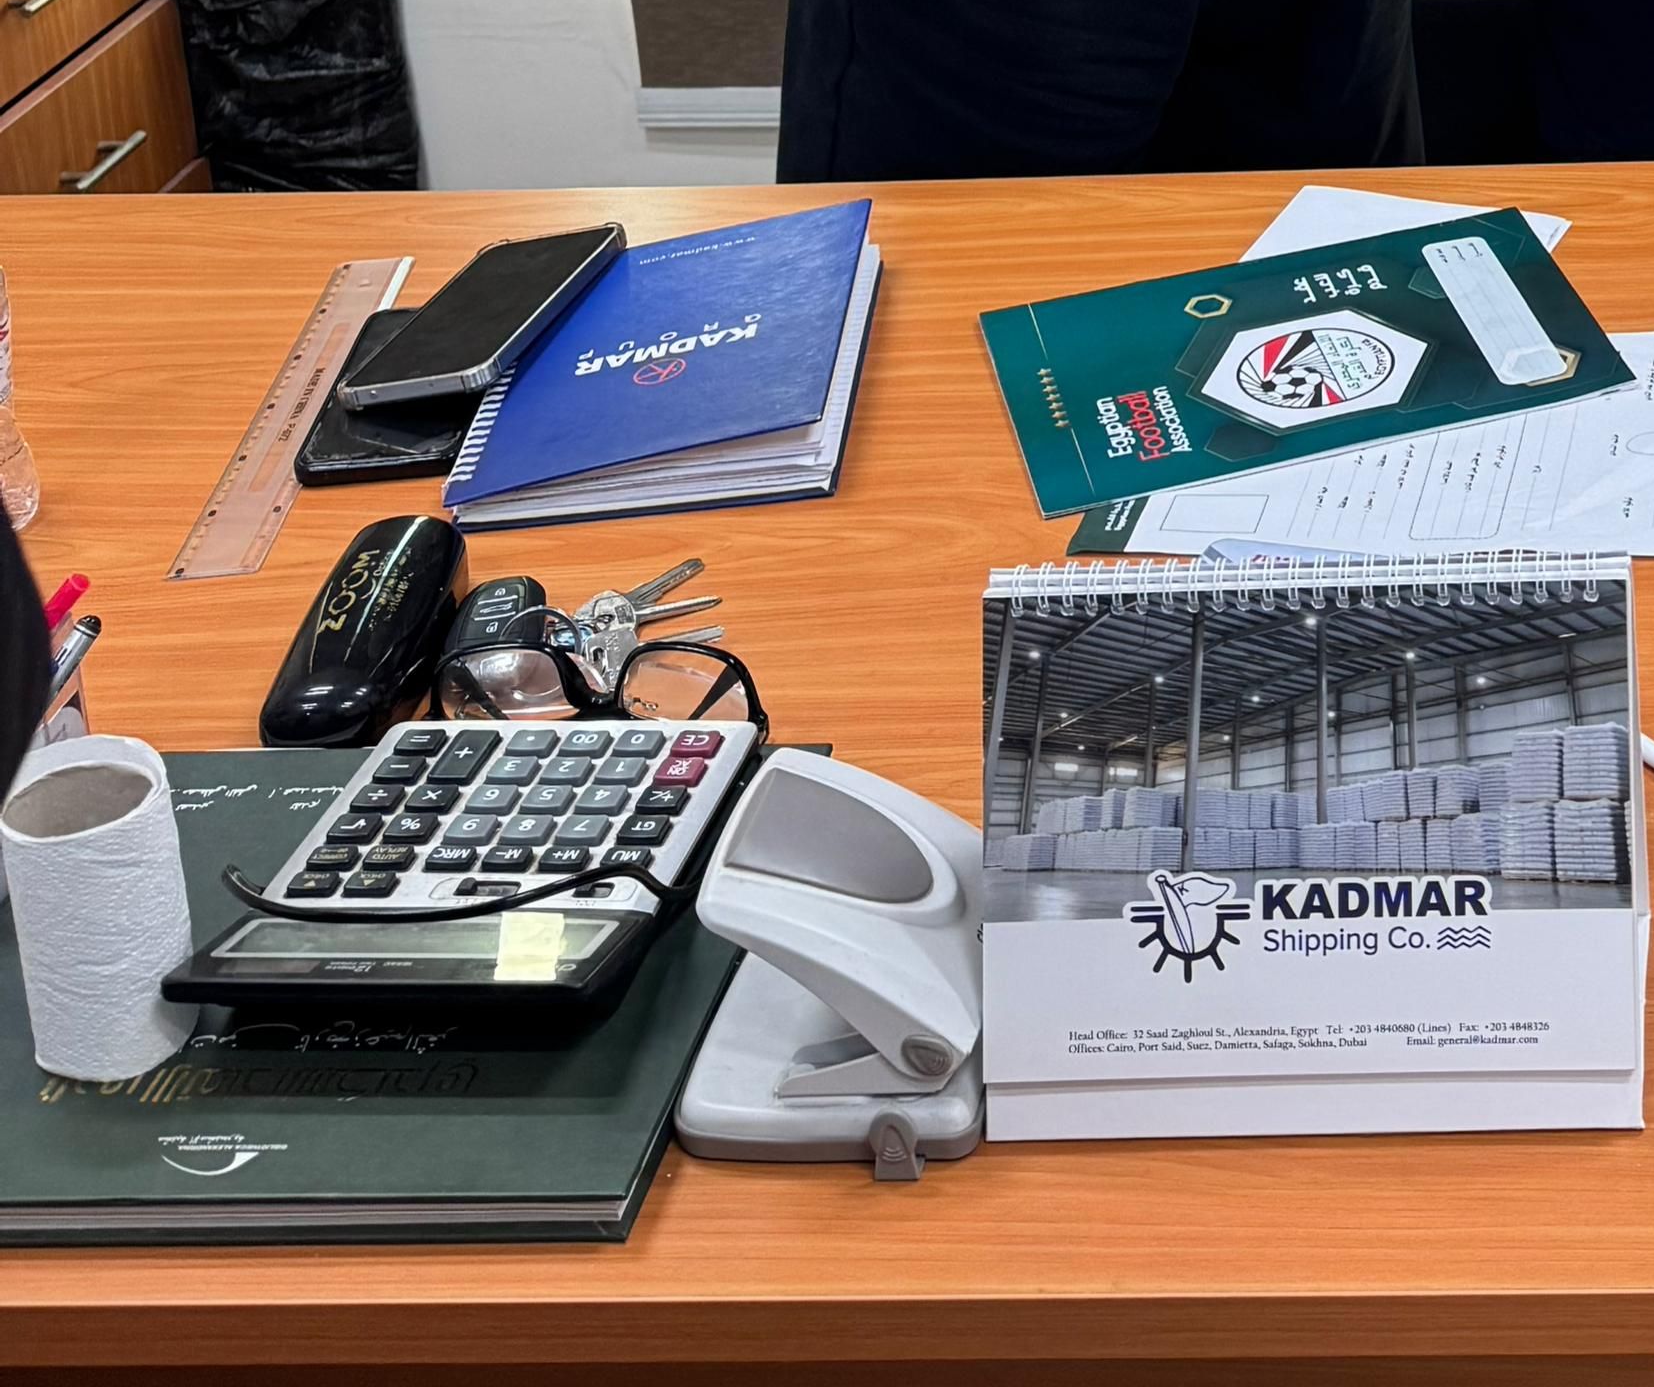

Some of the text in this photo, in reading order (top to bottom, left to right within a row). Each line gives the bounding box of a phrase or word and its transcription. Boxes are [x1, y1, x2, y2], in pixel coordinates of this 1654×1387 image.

[574, 322, 757, 376] KADMAR
[1153, 386, 1193, 452] Association
[1097, 397, 1136, 458] Egyptian
[1116, 391, 1170, 462] Football
[319, 549, 380, 631] ZOOM
[571, 733, 598, 744] 00
[680, 734, 709, 745] CE
[504, 760, 521, 771] 3
[558, 761, 575, 771] 2
[482, 789, 500, 800] 6
[539, 789, 556, 800] 5
[593, 789, 610, 800] 4
[463, 819, 481, 830] 9
[518, 819, 536, 831] 8
[573, 820, 588, 830] 7
[631, 821, 656, 830] GT
[432, 848, 470, 858] MRC
[552, 850, 580, 859] M+
[611, 851, 641, 860] MU
[1262, 879, 1490, 921] KADMAR
[1262, 925, 1431, 957] Shipping Co.
[1069, 1030, 1094, 1041] Head
[1133, 1029, 1144, 1039] 32
[1146, 1028, 1169, 1039] Saad
[1170, 1027, 1214, 1040] Zaghloul
[1233, 1026, 1289, 1039] Alexandria,
[1290, 1026, 1319, 1040] Egypt
[1107, 1042, 1137, 1053] Cairo,
[1139, 1041, 1160, 1052] Port
[1161, 1040, 1185, 1052] Said,
[1187, 1040, 1213, 1052] Suez,
[1214, 1039, 1262, 1051] Damietta,
[1263, 1038, 1296, 1052] Safaga,
[1298, 1038, 1337, 1050] Sokhna,
[1339, 1037, 1367, 1048] Dubai
[1437, 1034, 1539, 1048] general@kadmar.com
